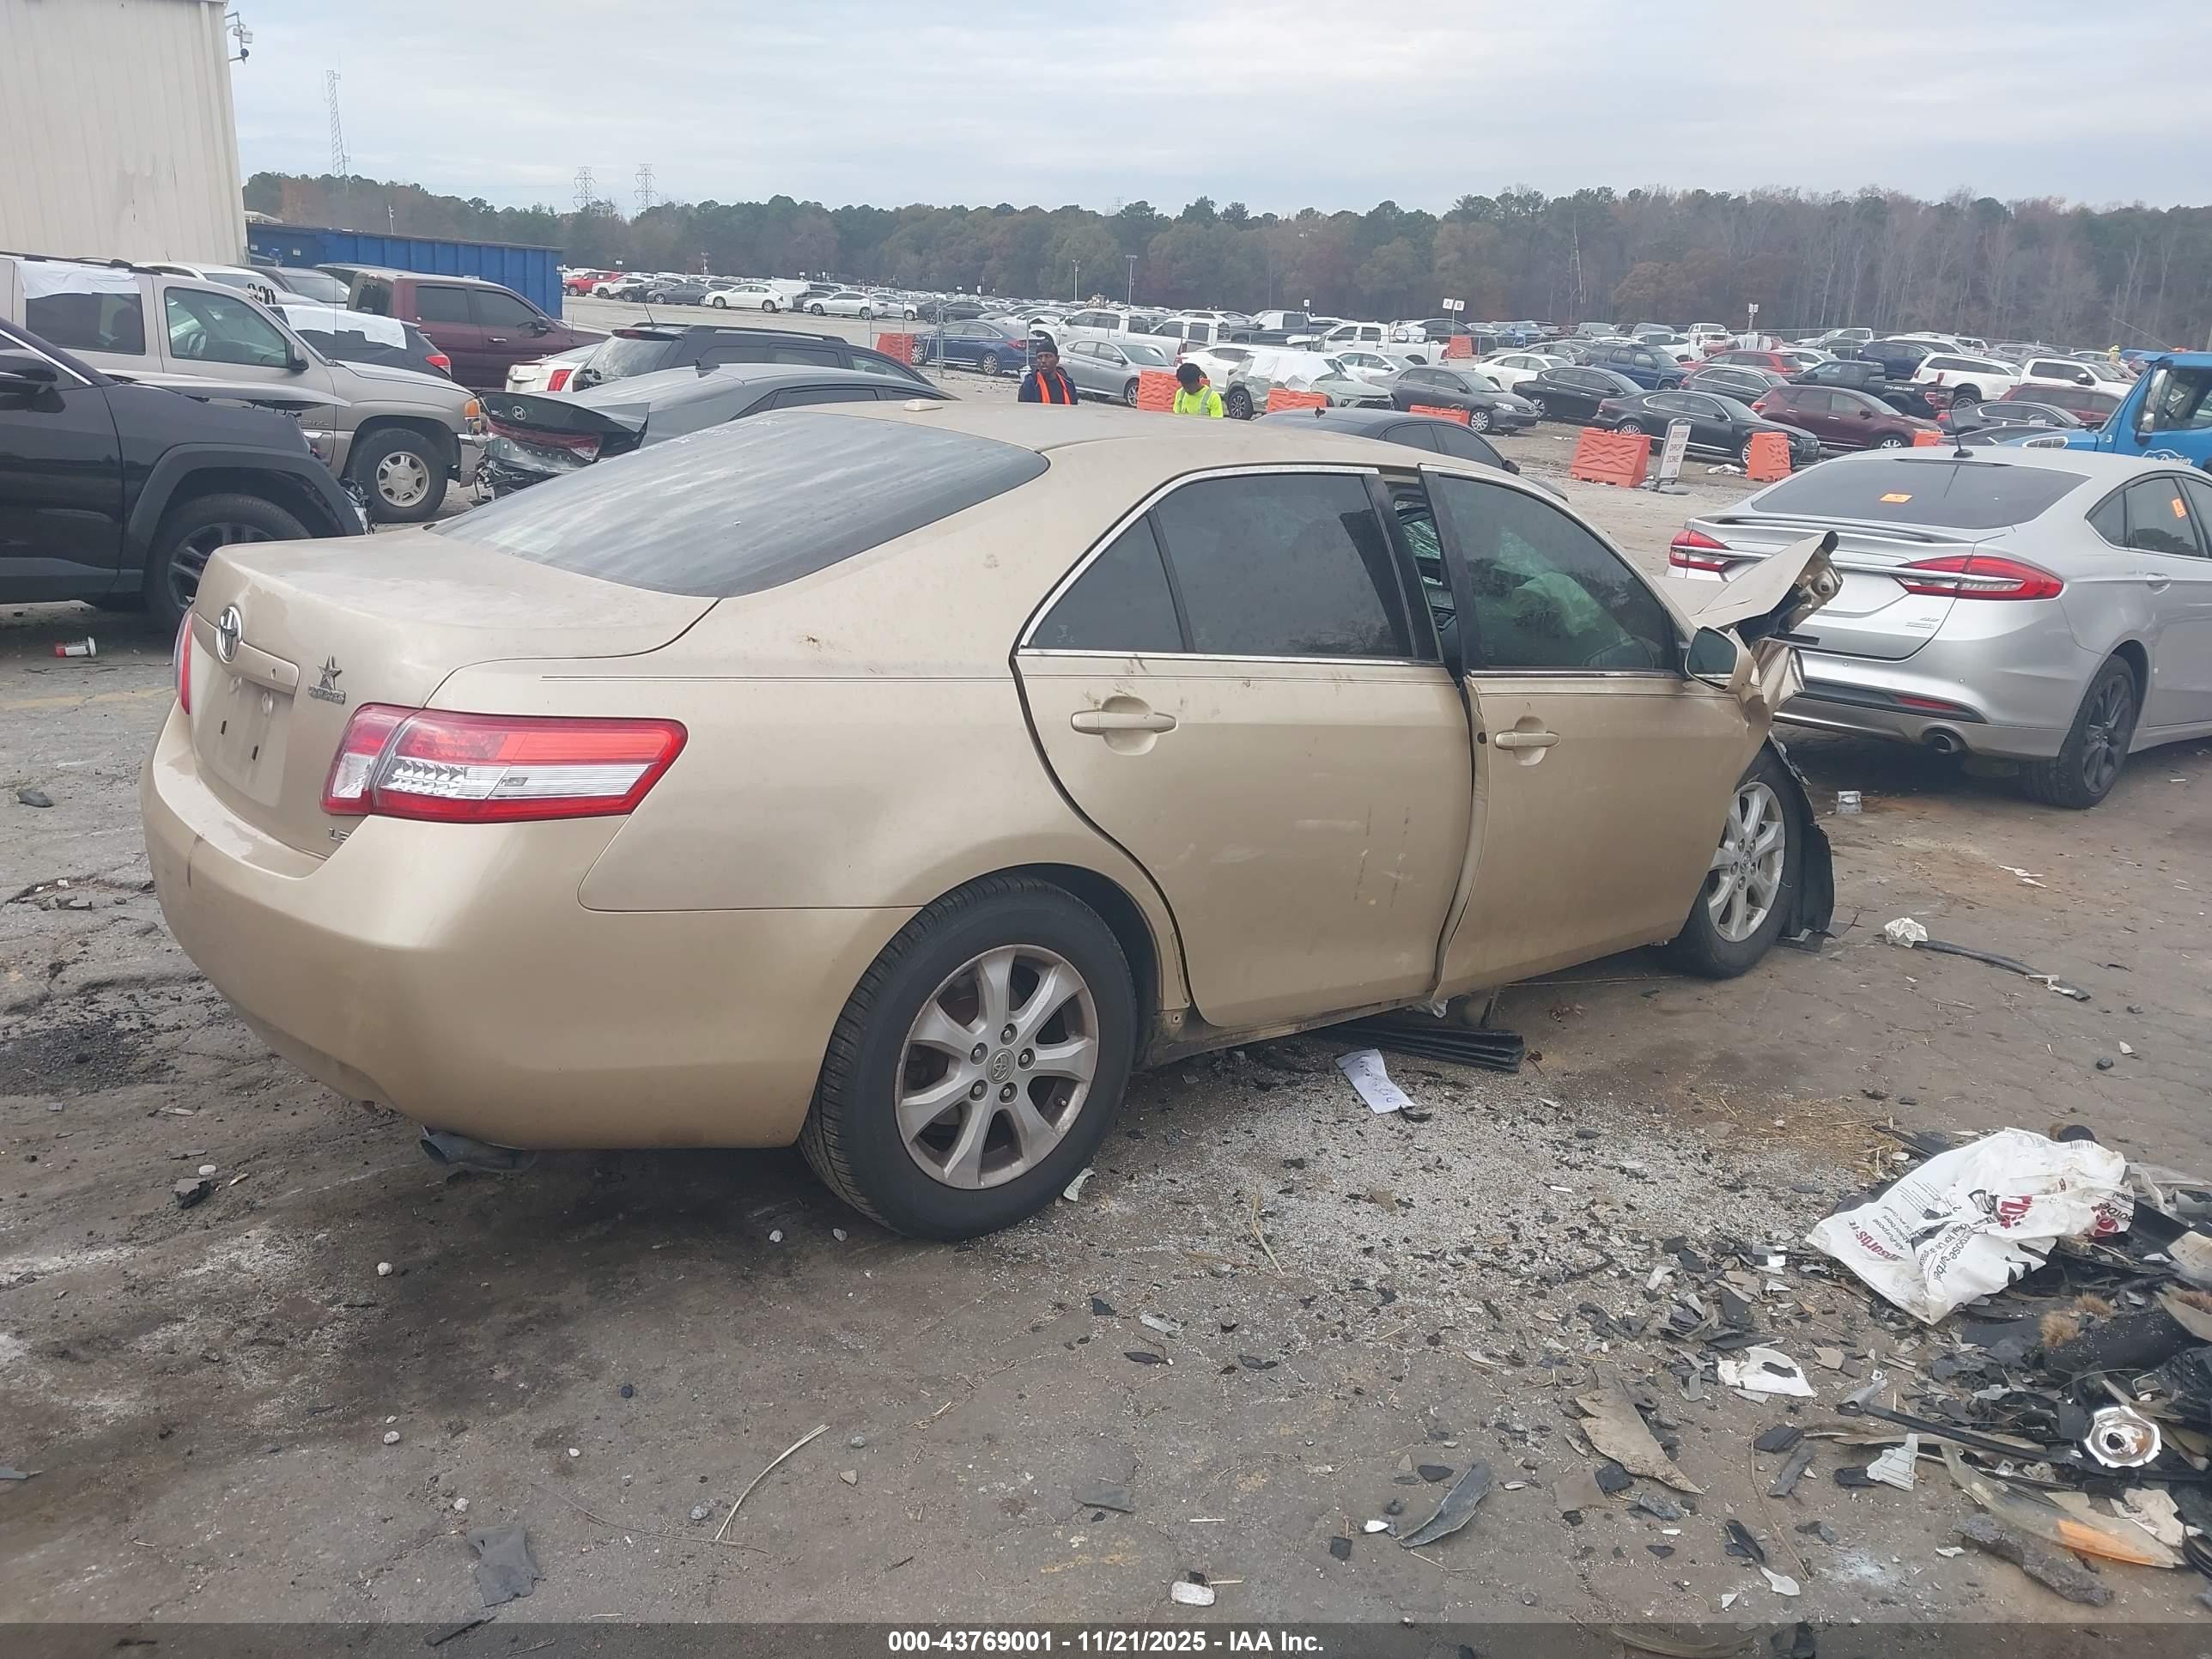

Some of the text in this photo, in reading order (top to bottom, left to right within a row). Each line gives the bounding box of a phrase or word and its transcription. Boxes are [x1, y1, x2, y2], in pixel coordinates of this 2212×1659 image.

[2106, 434, 2113, 443] 3
[504, 444, 572, 461] ELANTRA
[329, 827, 350, 843] LE
